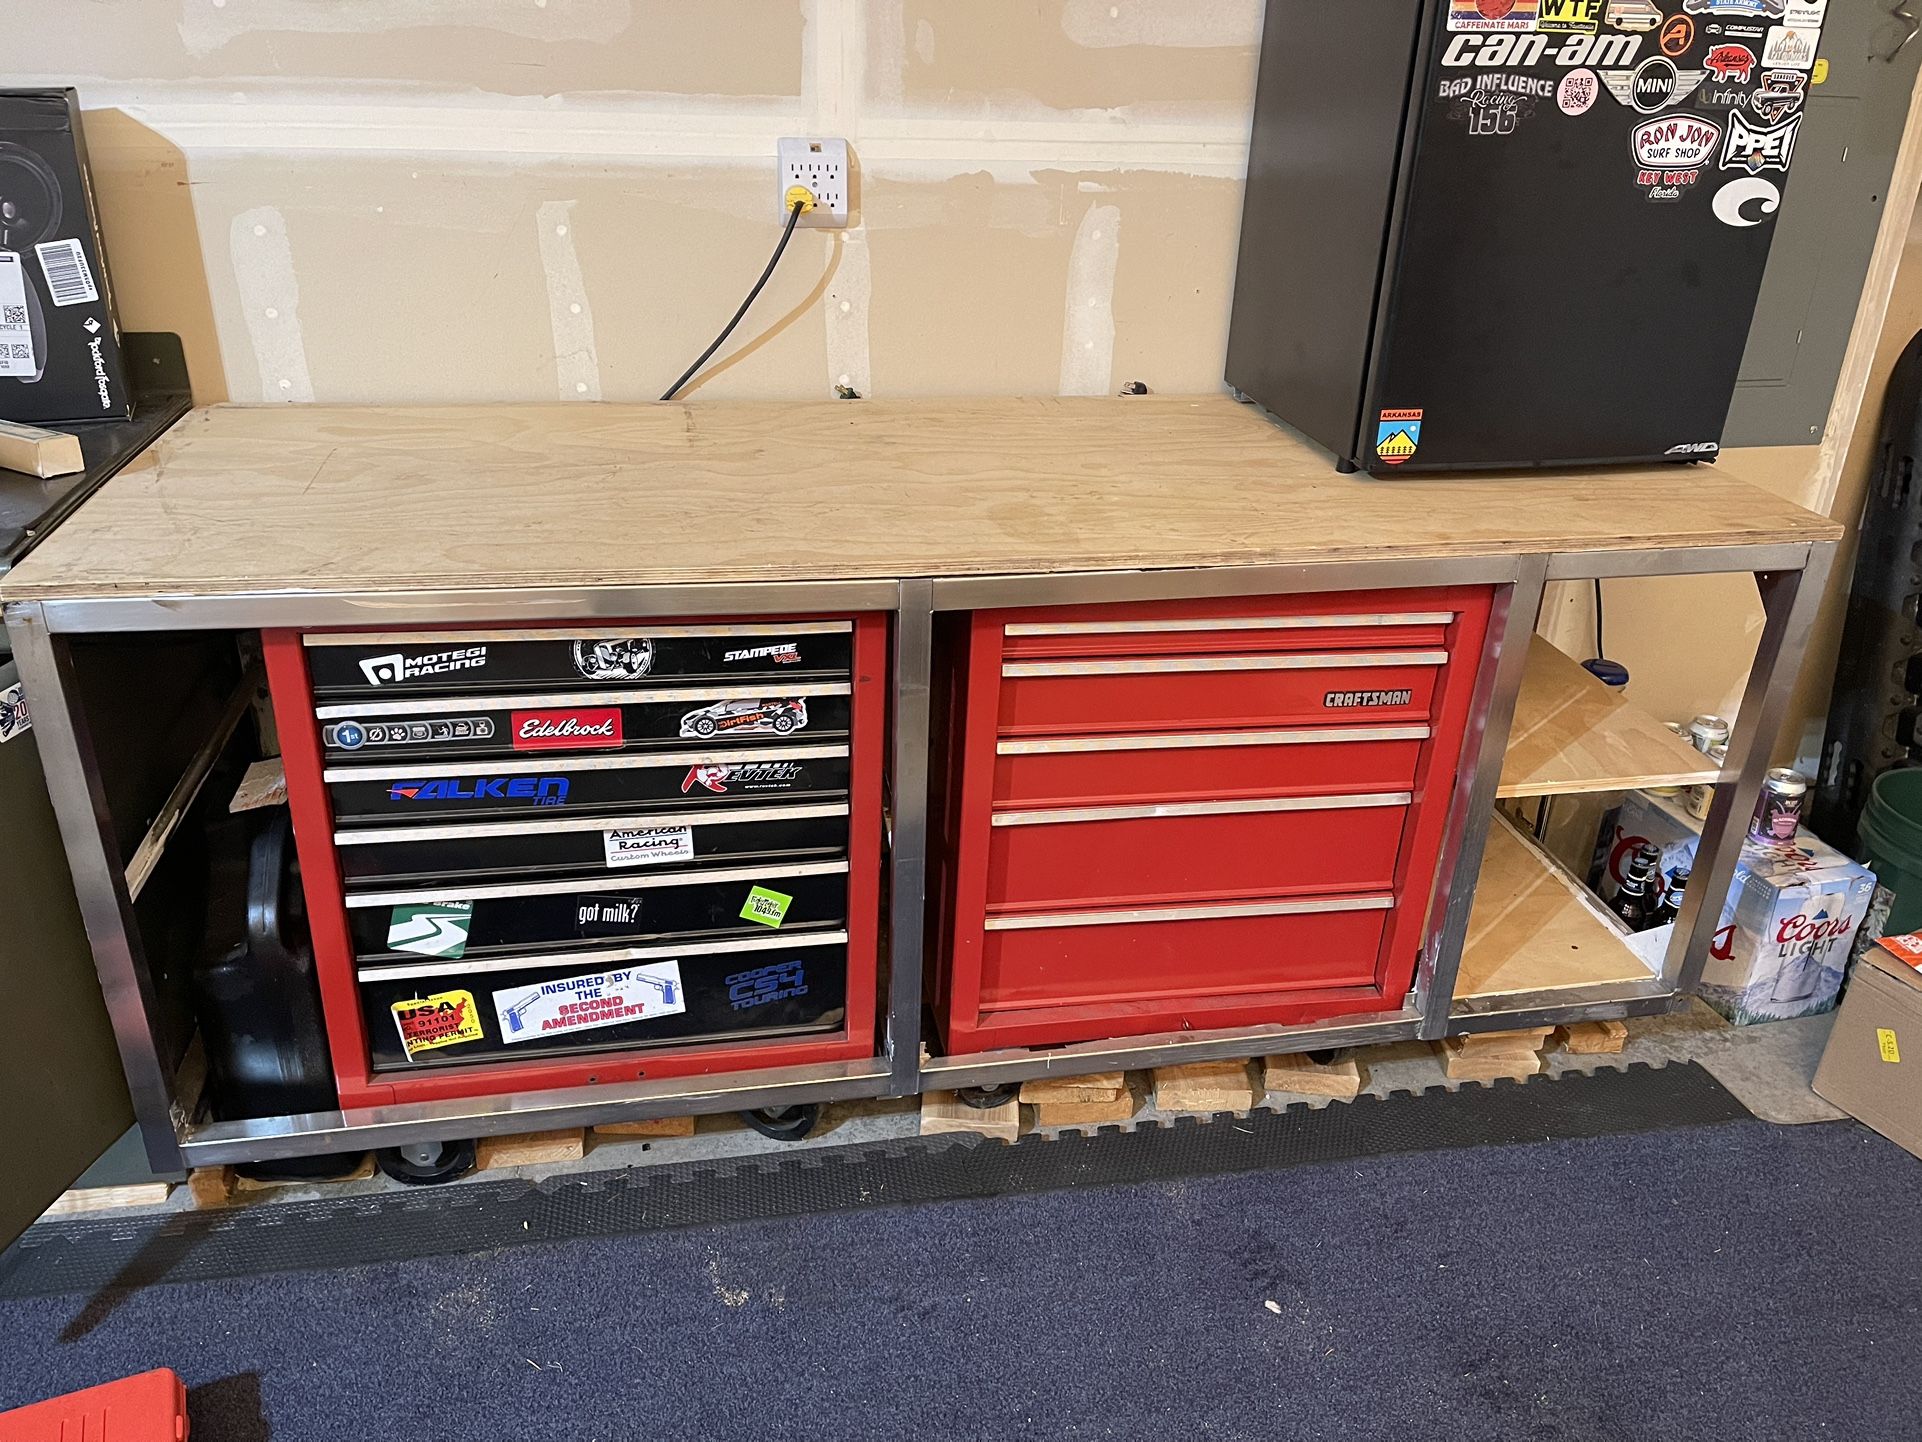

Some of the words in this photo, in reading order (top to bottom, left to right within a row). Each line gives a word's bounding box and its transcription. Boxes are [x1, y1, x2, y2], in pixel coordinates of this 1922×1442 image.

[1544, 0, 1600, 17] WTF
[1455, 21, 1505, 29] CAFFEINATE
[1441, 34, 1643, 66] can-am
[1711, 51, 1750, 64] Arkansas
[1439, 77, 1473, 97] BAD
[1476, 73, 1554, 96] INFLUENCE
[1637, 78, 1672, 93] MINI
[1460, 89, 1527, 111] Racing
[1712, 88, 1751, 108] Infinity
[1469, 104, 1517, 134] 156
[1640, 123, 1678, 149] RON
[1680, 125, 1714, 147] JON
[1726, 123, 1793, 162] PPEI
[1647, 149, 1670, 158] SURF
[1675, 149, 1700, 158] SHOP
[1637, 170, 1661, 185] KEY
[1664, 170, 1698, 184] WEST
[1649, 186, 1680, 198] Florida
[1382, 411, 1421, 419] ARKANSAS
[1664, 442, 1718, 454] AWD
[405, 647, 487, 667] MOTEGI
[723, 643, 797, 661] STAMPEDE
[405, 657, 486, 678] RACING
[1325, 690, 1412, 707] CRAFTSMAN
[13, 700, 28, 720] 20
[341, 729, 359, 743] 1st
[519, 718, 614, 738] Edelbrock
[388, 777, 570, 800] FALKEN
[532, 796, 567, 806] TIRE
[609, 826, 687, 839] American
[619, 838, 679, 850] Racing
[610, 853, 650, 861] Custom
[651, 850, 689, 858] Wheels
[1857, 882, 1873, 894] 36
[578, 906, 600, 925] got
[602, 904, 640, 923] milk?
[1776, 914, 1852, 943] Coors
[1778, 938, 1837, 958] LIGHT
[725, 960, 802, 985] COOPER
[540, 976, 604, 996] INSURED
[613, 971, 632, 983] BY
[729, 969, 804, 1001] CS4
[575, 988, 603, 1001] THE
[730, 985, 809, 1010] TOURING
[397, 1001, 456, 1020] USA
[558, 995, 624, 1016] SECOND
[418, 1014, 456, 1028] 91101
[541, 1003, 645, 1031] AMENDMENT
[407, 1023, 459, 1038] TERRORIST
[439, 1027, 473, 1039] PERMIT
